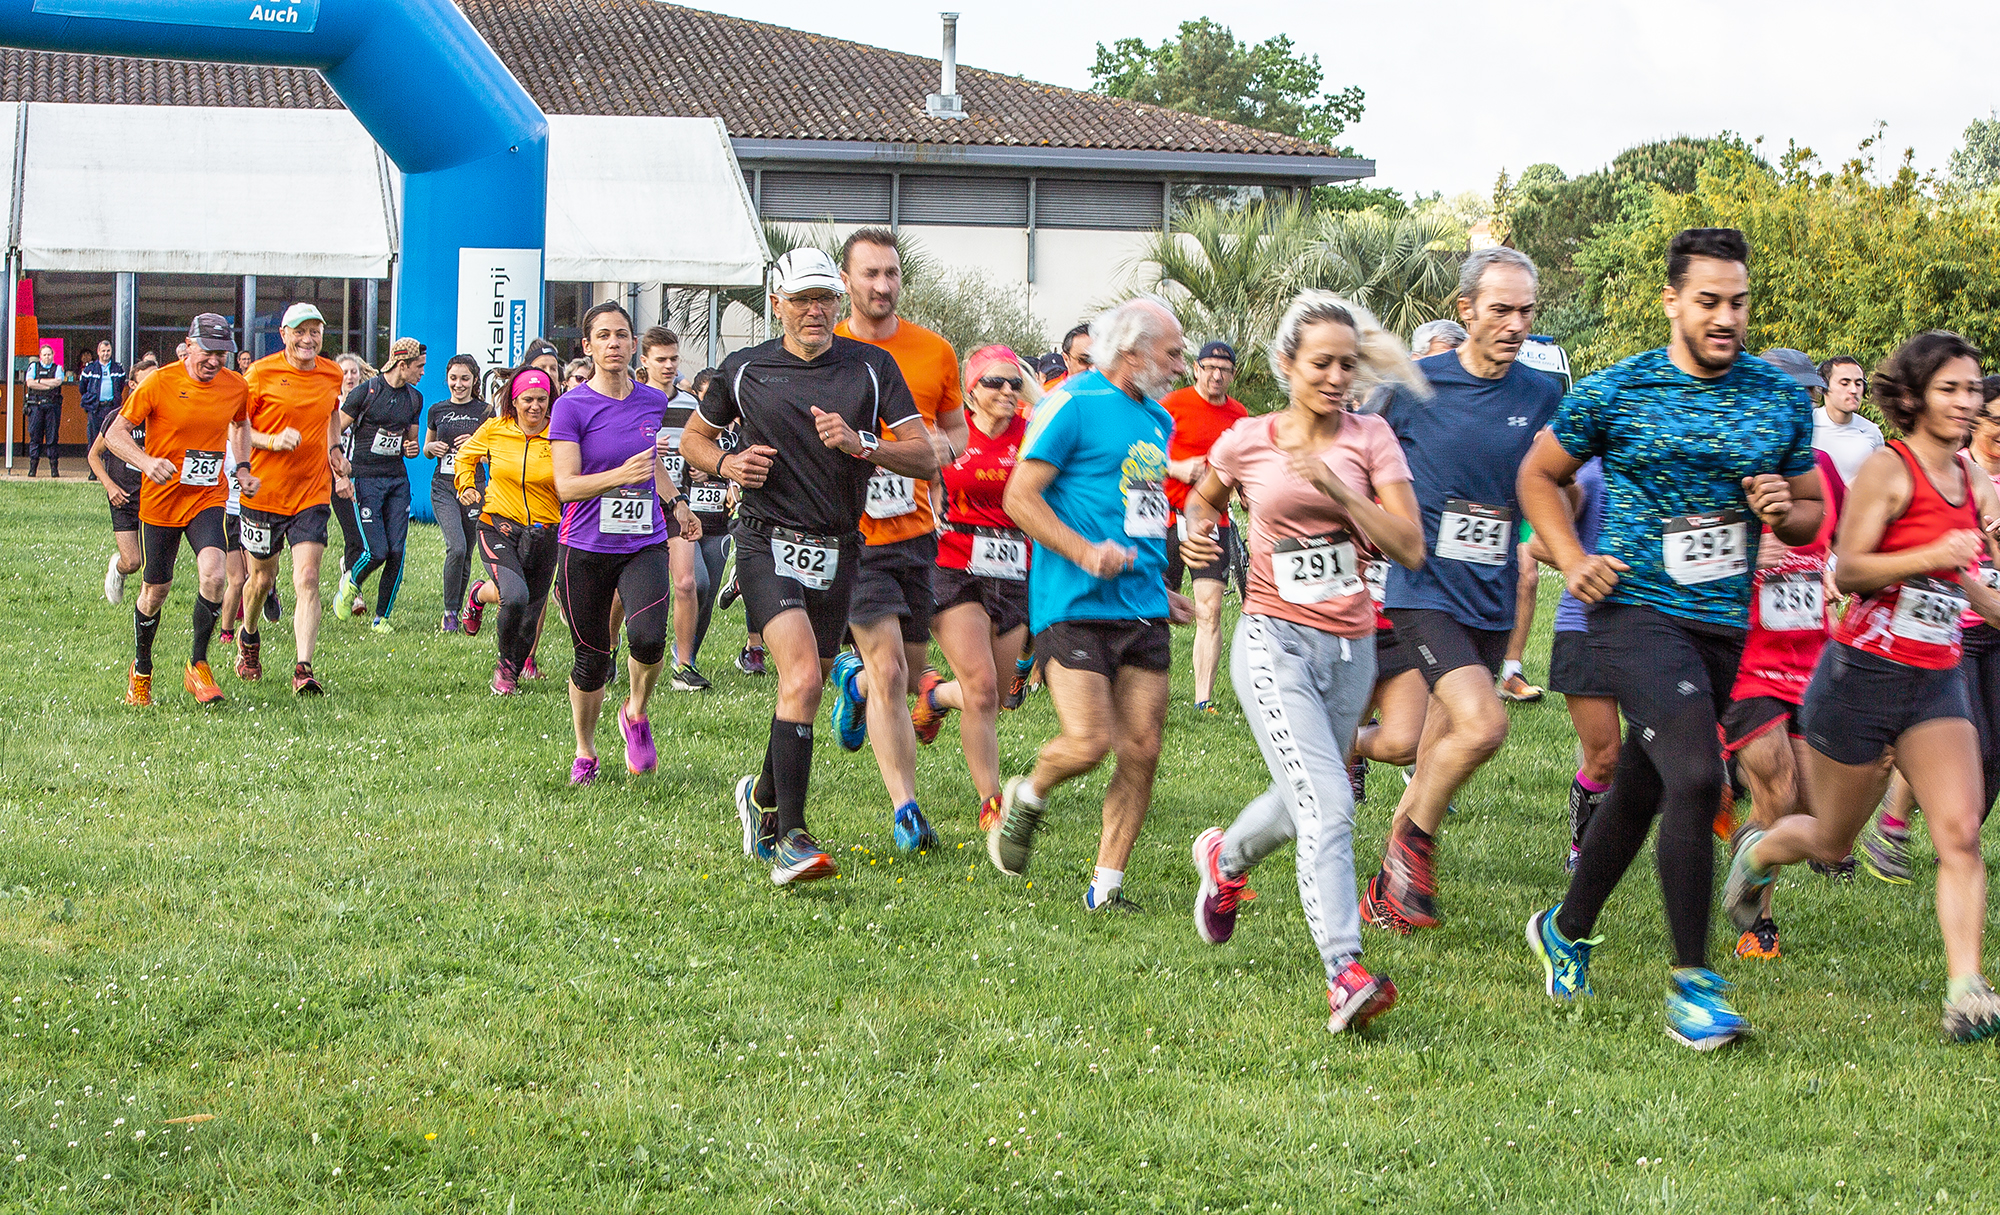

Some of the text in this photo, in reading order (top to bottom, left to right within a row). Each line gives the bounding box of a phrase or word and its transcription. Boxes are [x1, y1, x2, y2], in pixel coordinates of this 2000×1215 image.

[249, 5, 299, 23] Auch
[379, 436, 399, 448] 276
[191, 459, 217, 475] 263
[661, 456, 681, 472] 36
[696, 489, 721, 504] 238
[611, 500, 645, 520] 240
[243, 525, 264, 543] 203
[1454, 517, 1504, 546] 264
[1681, 528, 1734, 562] 292
[783, 544, 826, 573] 262
[1291, 547, 1344, 581] 291
[1250, 665, 1283, 725] YOUR
[1270, 728, 1304, 775] BAE
